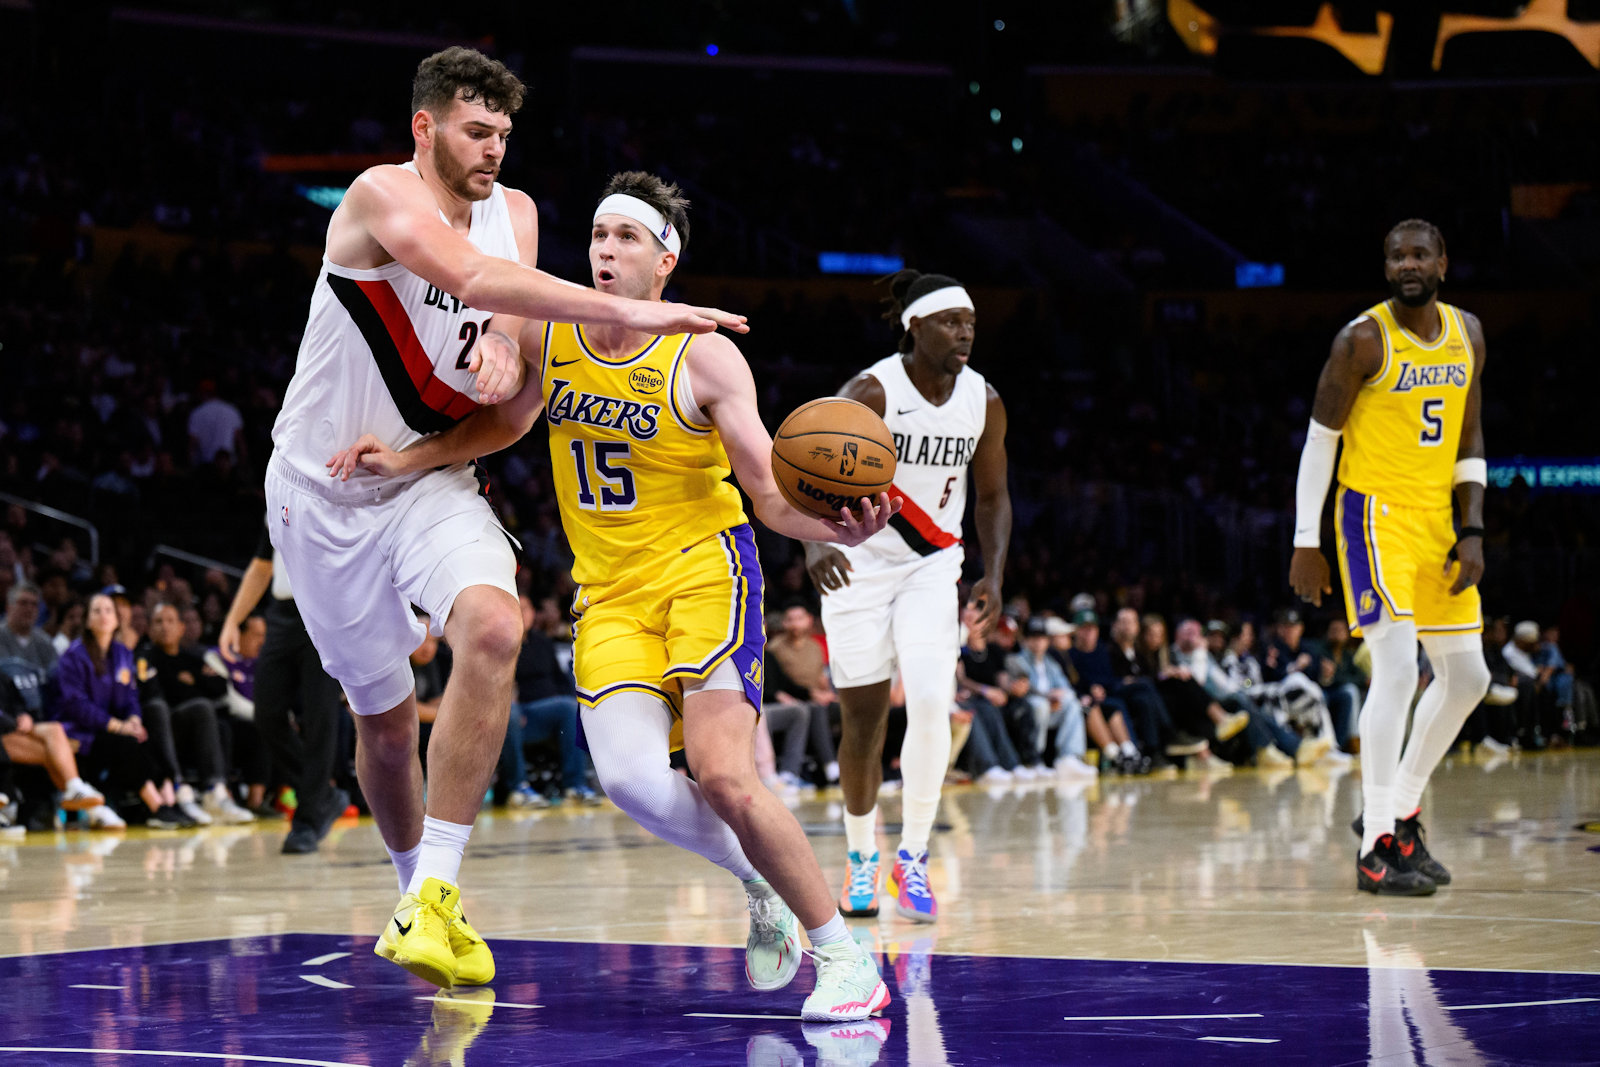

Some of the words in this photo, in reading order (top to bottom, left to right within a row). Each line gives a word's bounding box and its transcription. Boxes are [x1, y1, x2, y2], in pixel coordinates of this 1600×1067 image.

[455, 318, 491, 370] 2
[632, 372, 663, 388] bibigo
[1389, 361, 1467, 392] LAKERS
[547, 378, 661, 440] LAKERS
[1418, 398, 1445, 447] 5
[892, 433, 975, 467] BLAZERS
[569, 438, 638, 511] 15
[939, 476, 957, 510] 5
